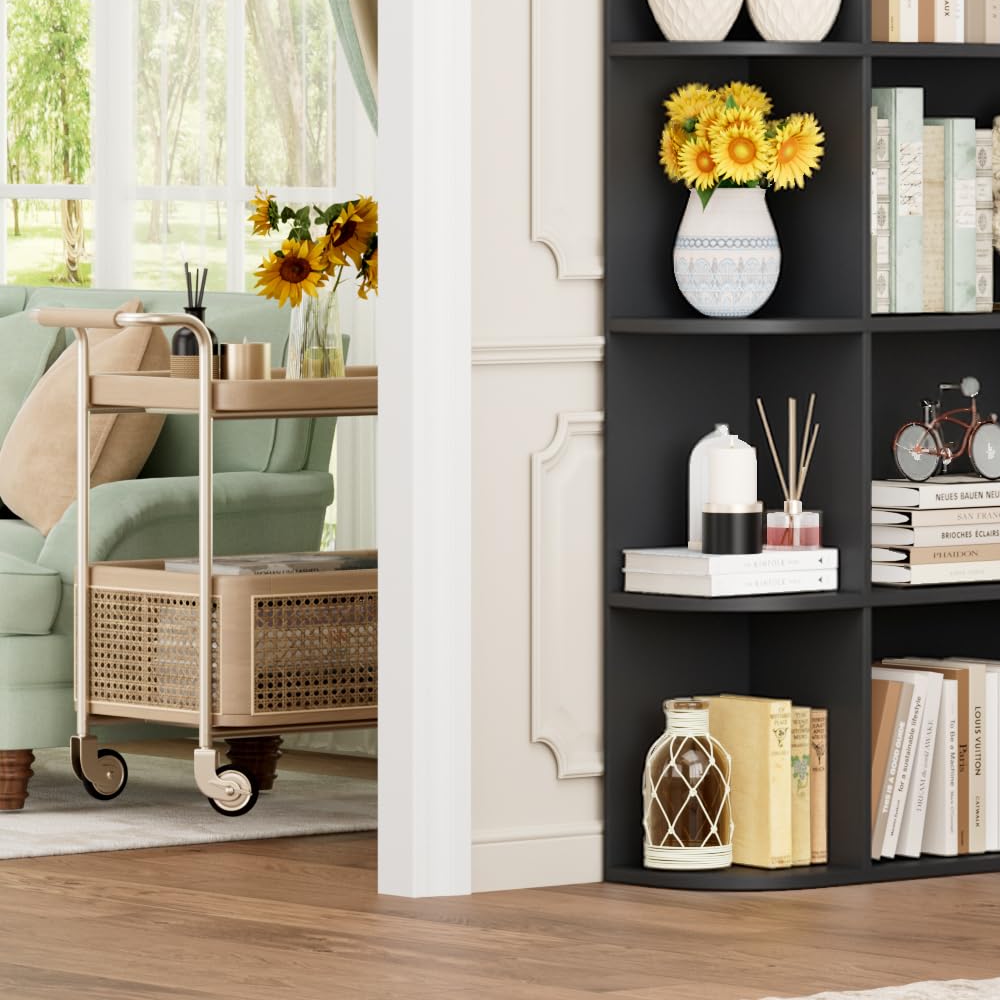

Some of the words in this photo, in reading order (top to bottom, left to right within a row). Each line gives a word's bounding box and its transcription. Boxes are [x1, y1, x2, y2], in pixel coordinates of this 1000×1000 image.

[935, 493, 958, 502] NEUES
[960, 491, 984, 501] BAUEN
[957, 512, 974, 521] SAN
[941, 531, 972, 539] BRIOCHES
[933, 550, 979, 559] PHAIDON
[949, 719, 956, 728] To
[974, 706, 982, 734] LOUIS
[903, 727, 915, 772] sustainable
[911, 696, 922, 726] lifestyle
[949, 731, 956, 743] Be
[974, 736, 982, 776] VUITTON
[882, 794, 890, 814] THIS
[890, 749, 900, 776] GOOD
